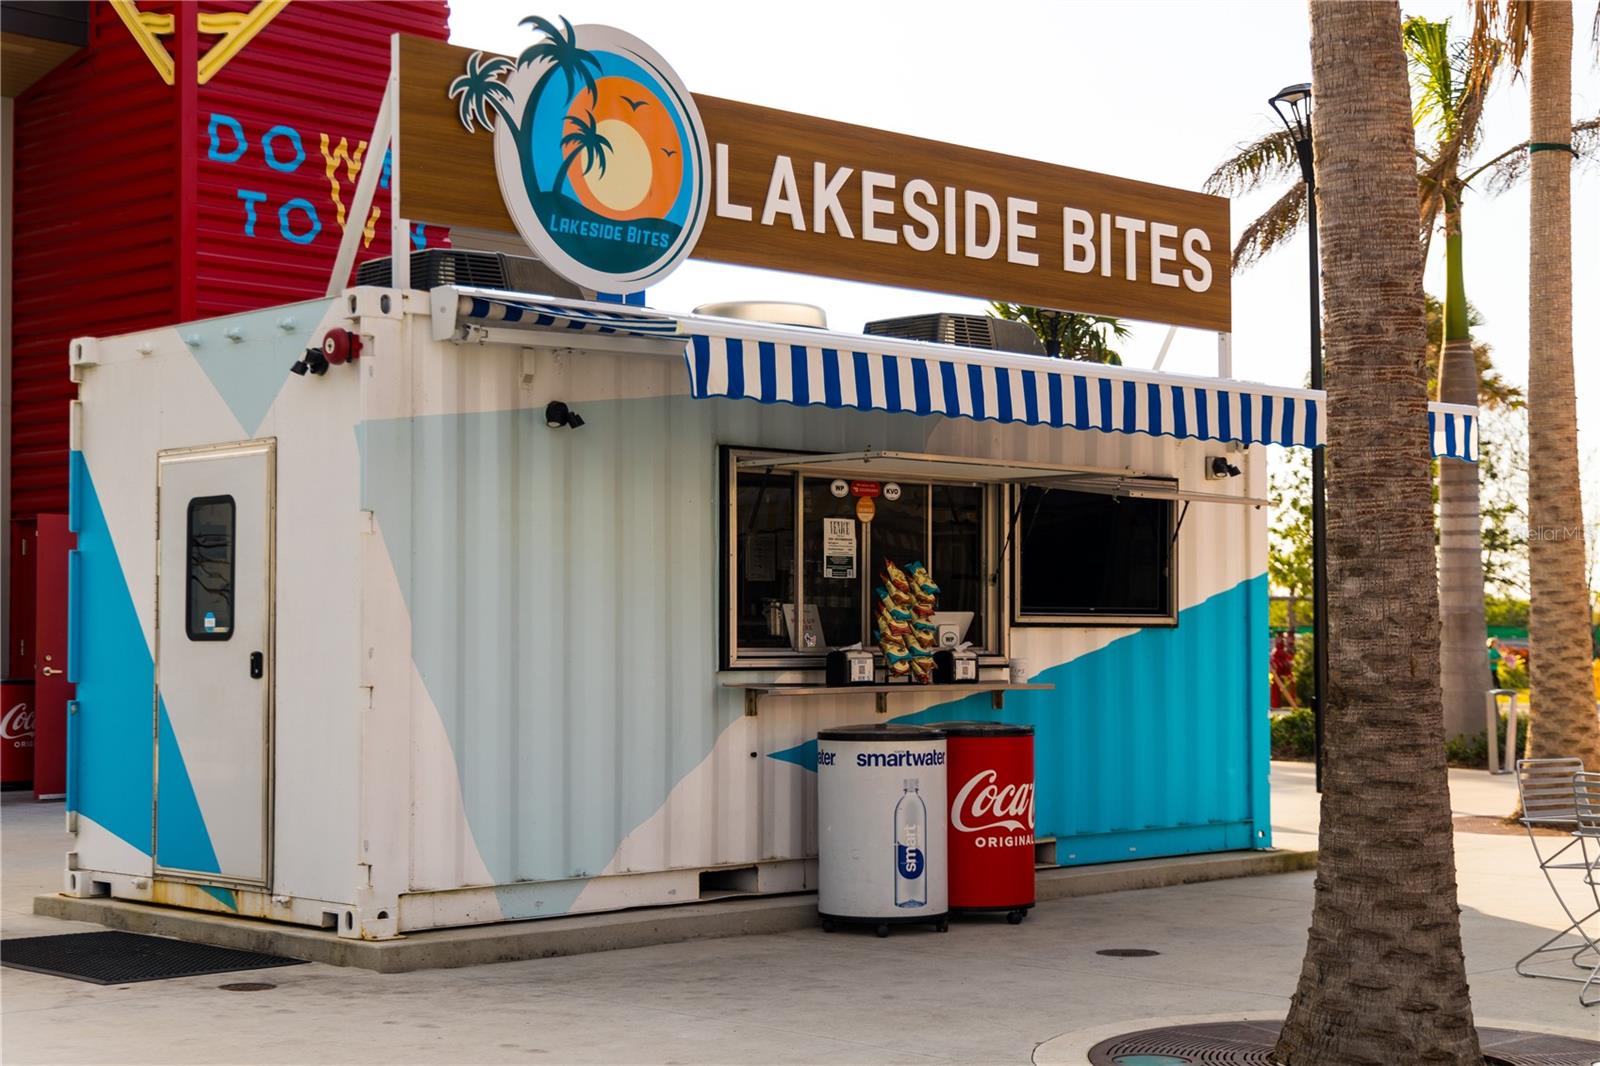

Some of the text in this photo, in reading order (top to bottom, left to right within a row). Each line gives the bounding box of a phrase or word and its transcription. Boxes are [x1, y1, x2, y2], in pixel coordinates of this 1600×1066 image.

[208, 112, 392, 190] DOW
[550, 213, 670, 248] LAKESIDE BITES
[715, 142, 1213, 293] LAKESIDE BITES
[856, 749, 946, 768] smartwater
